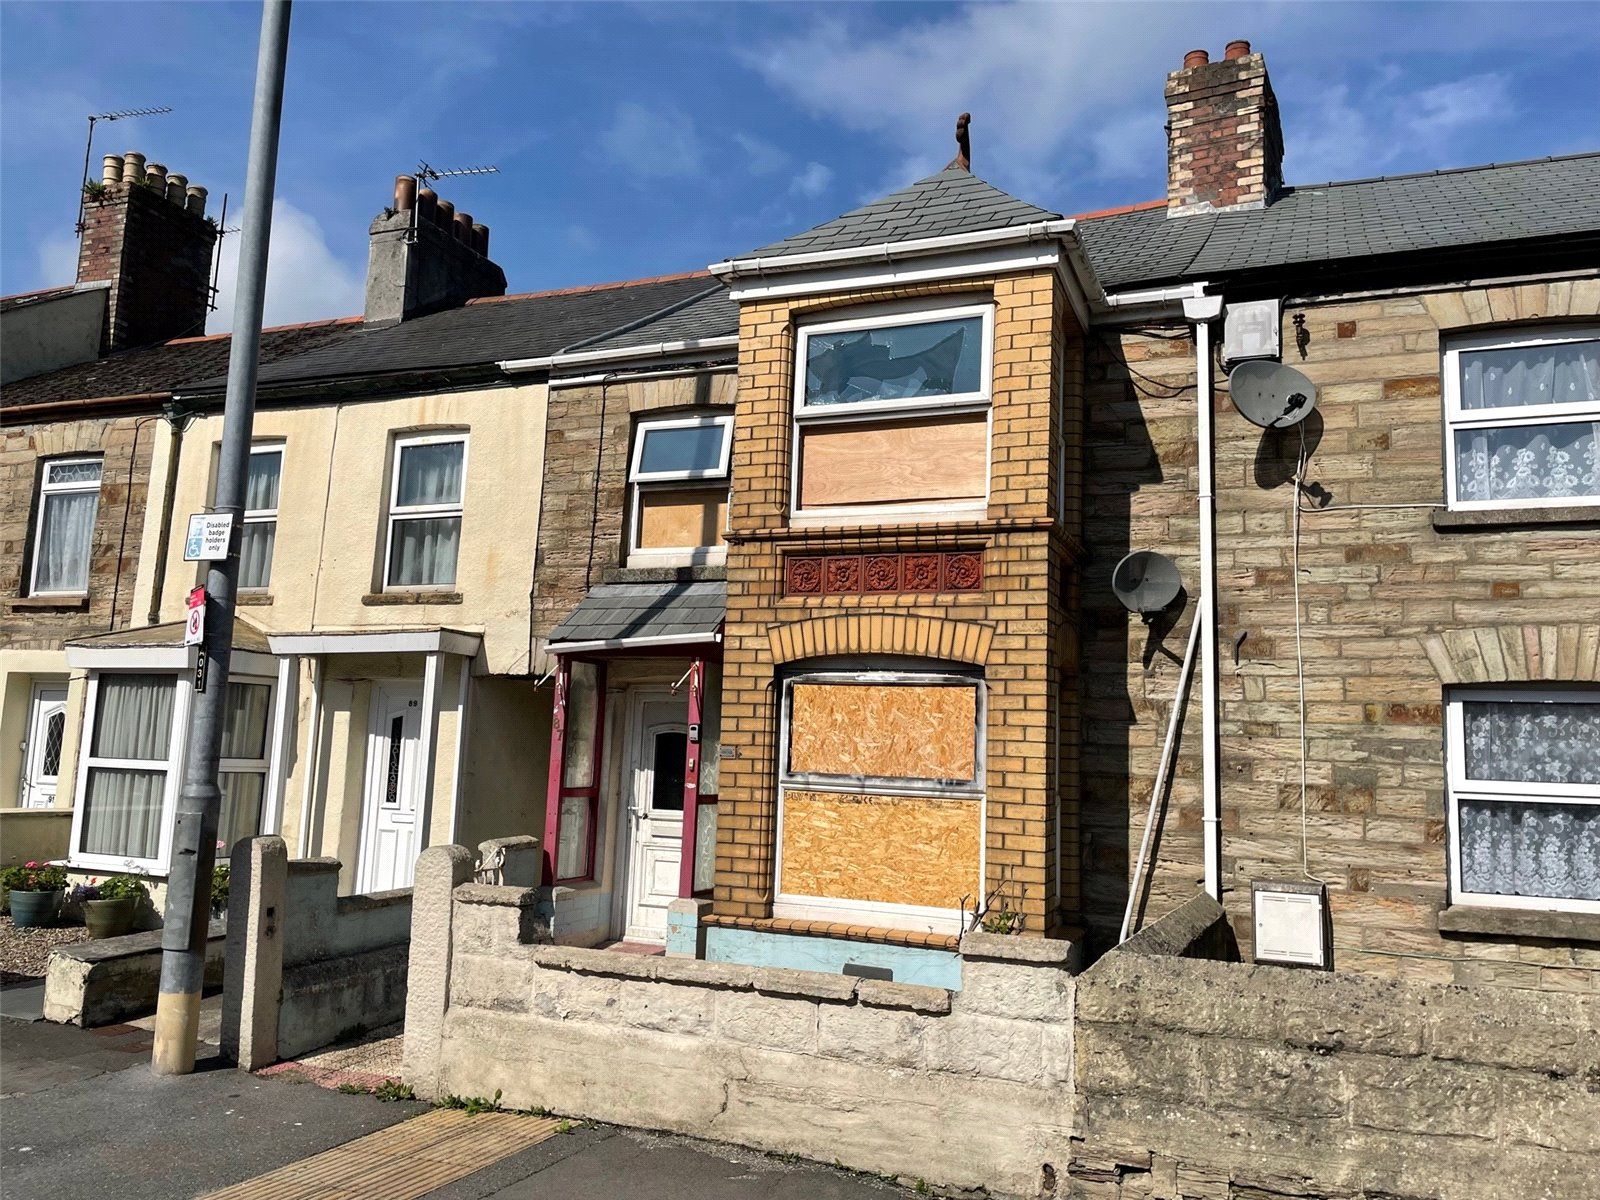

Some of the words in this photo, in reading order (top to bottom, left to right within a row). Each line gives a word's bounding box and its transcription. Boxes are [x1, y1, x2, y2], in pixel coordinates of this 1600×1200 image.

[206, 521, 230, 529] Disabled
[208, 529, 225, 537] badge
[208, 544, 220, 552] only
